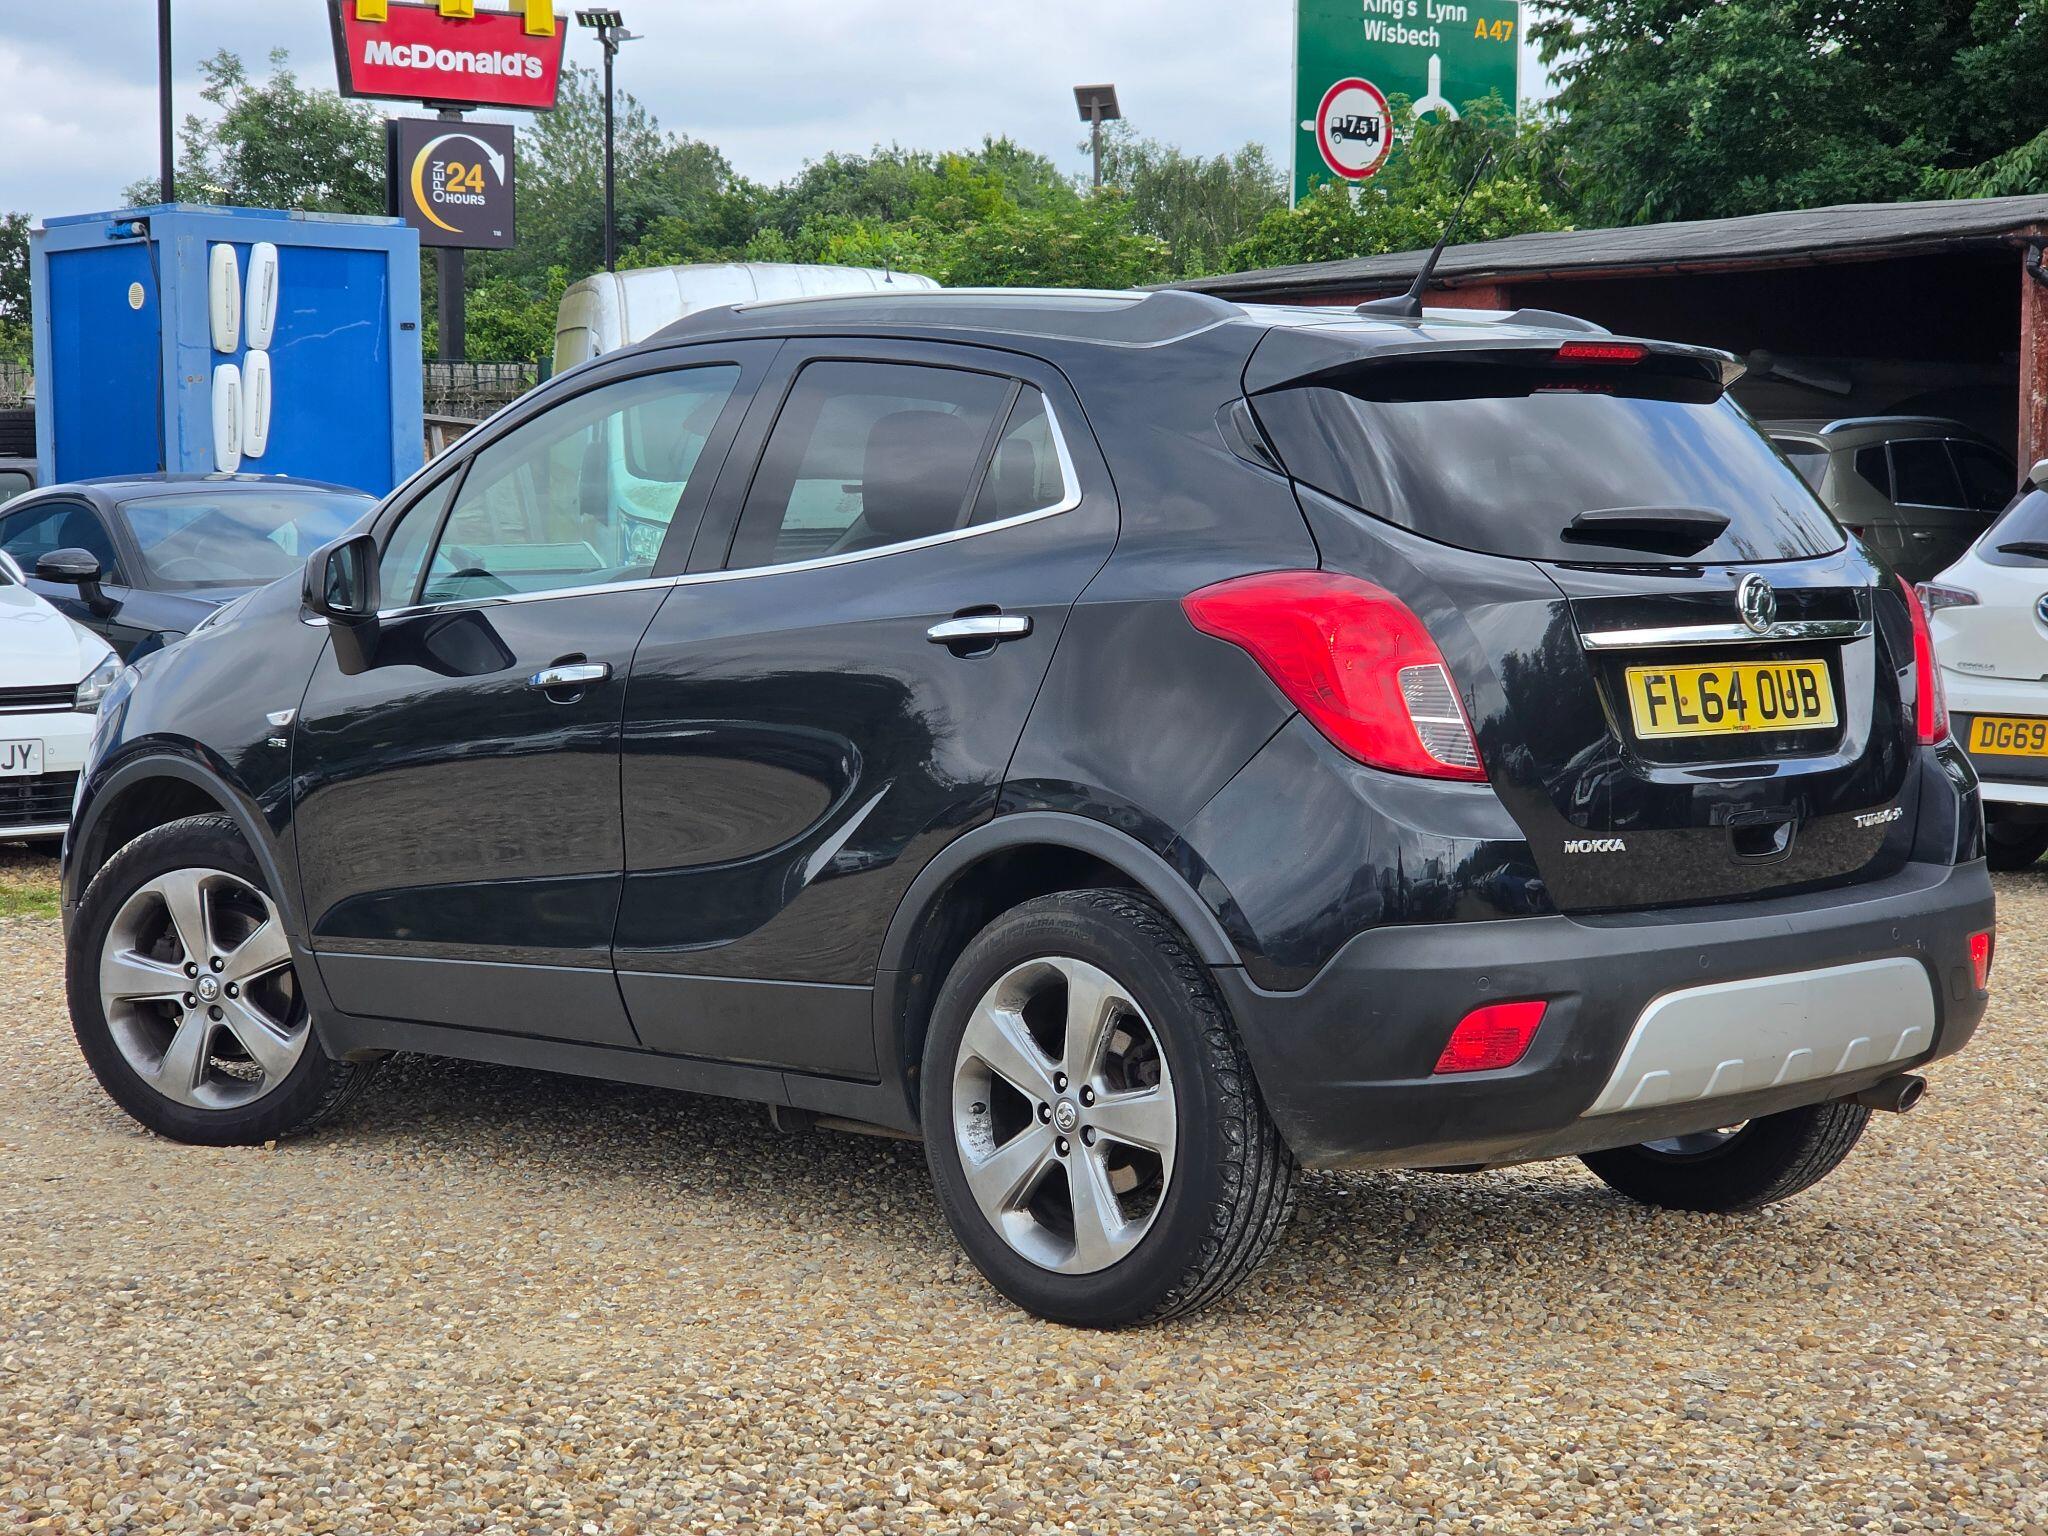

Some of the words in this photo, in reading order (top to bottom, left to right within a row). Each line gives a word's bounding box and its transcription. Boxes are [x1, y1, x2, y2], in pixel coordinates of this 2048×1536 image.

[1363, 0, 1417, 19] Kings
[1427, 0, 1467, 23] Lynn
[1364, 19, 1440, 47] Wisbech
[1474, 18, 1514, 42] A47
[364, 40, 543, 78] McDonald's
[432, 161, 445, 203] OPEN
[446, 162, 485, 193] 24
[446, 193, 486, 206] HOURS
[1644, 672, 1748, 726] FL64
[1756, 668, 1821, 720] OUB
[1980, 721, 2047, 750] DG69
[0, 744, 32, 770] JY
[1563, 838, 1627, 854] MOKKA
